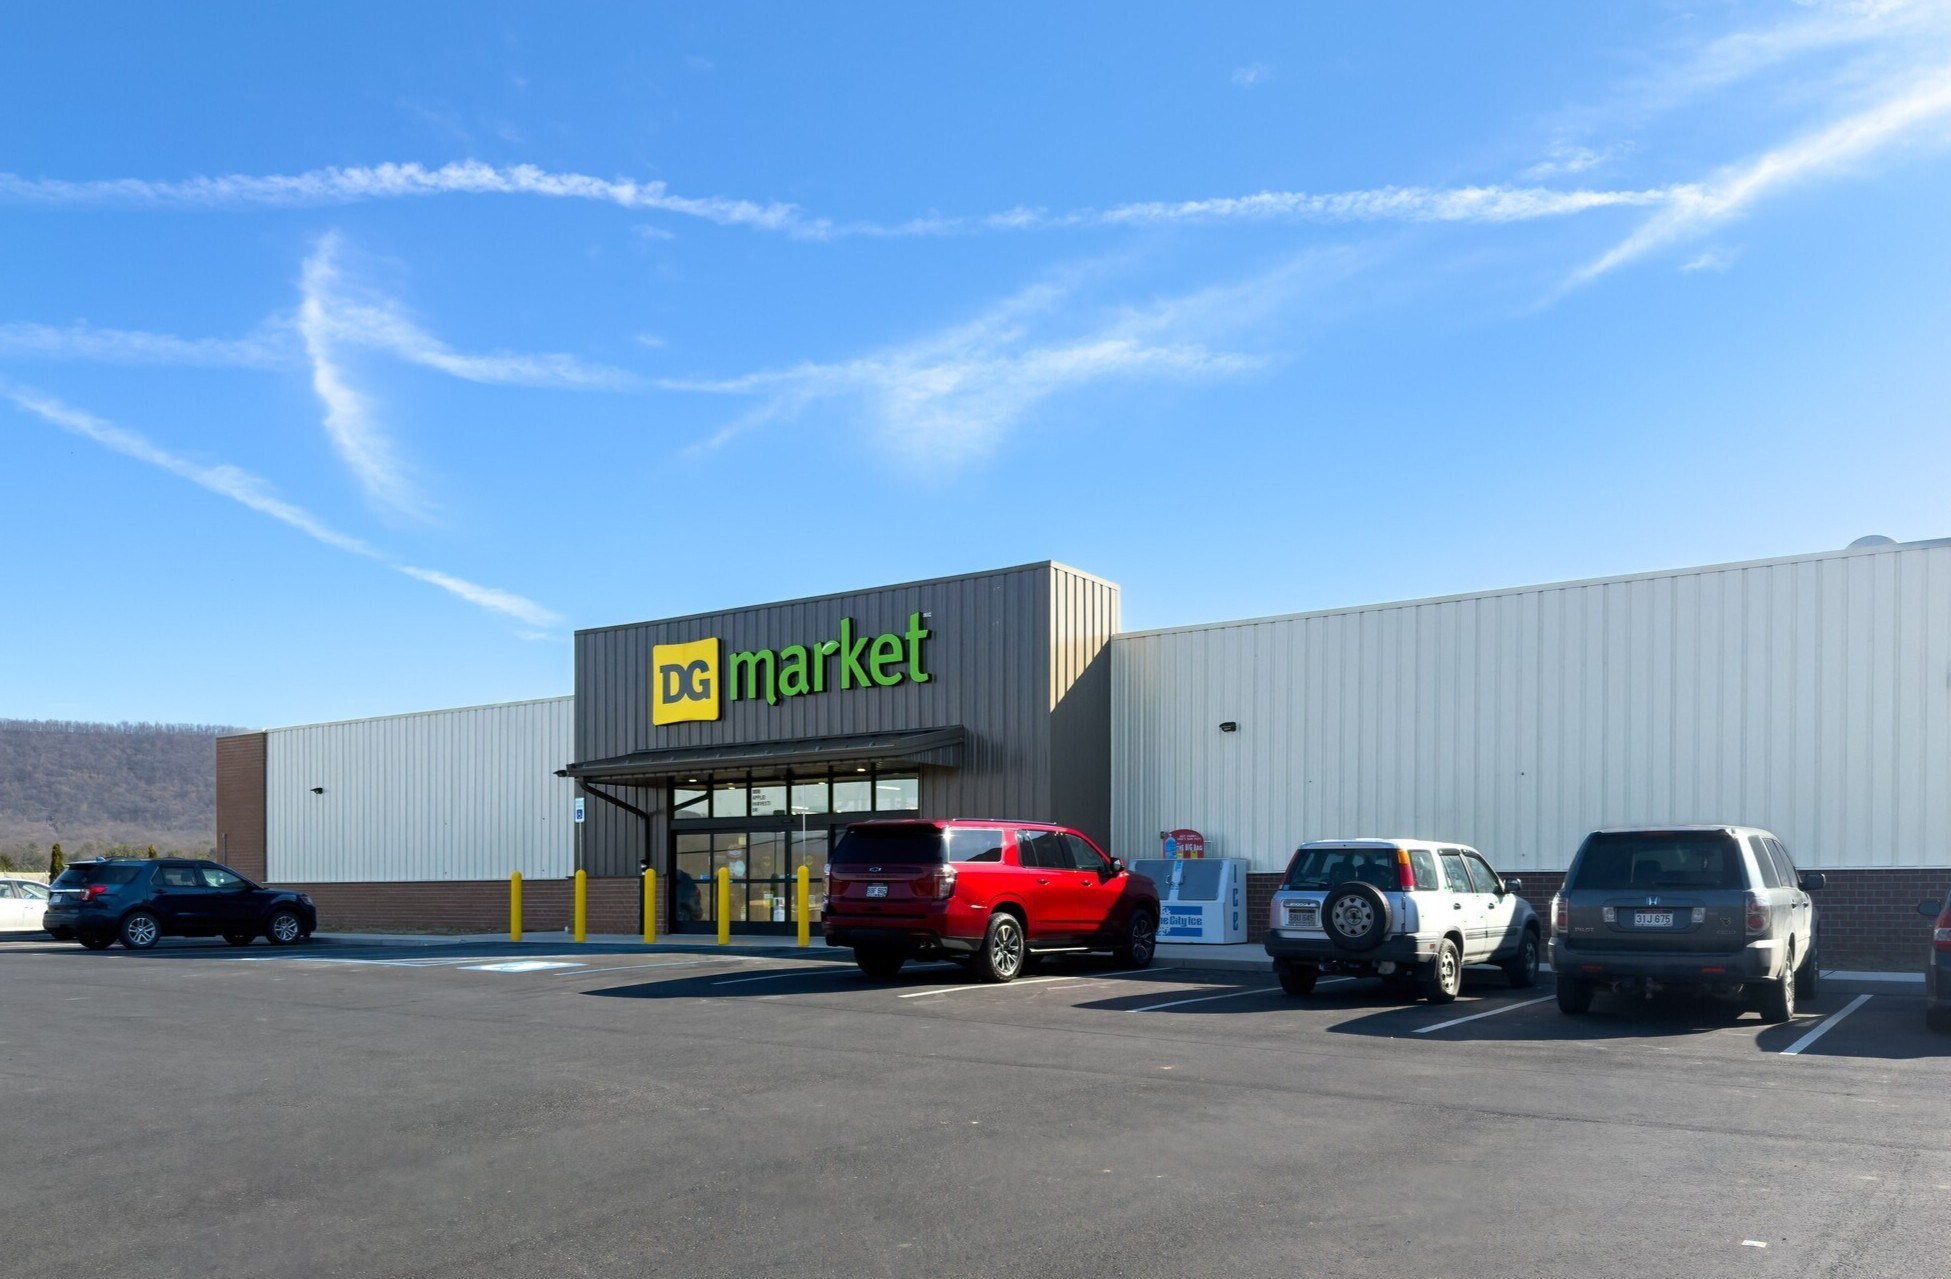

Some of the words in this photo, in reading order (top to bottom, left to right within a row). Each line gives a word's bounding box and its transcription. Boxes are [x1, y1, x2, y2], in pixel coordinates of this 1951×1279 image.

[660, 659, 711, 704] DG
[729, 611, 930, 706] market
[1169, 916, 1187, 927] City
[1188, 916, 1202, 926] Ice
[1636, 914, 1653, 924] 31J
[1655, 914, 1671, 924] 675
